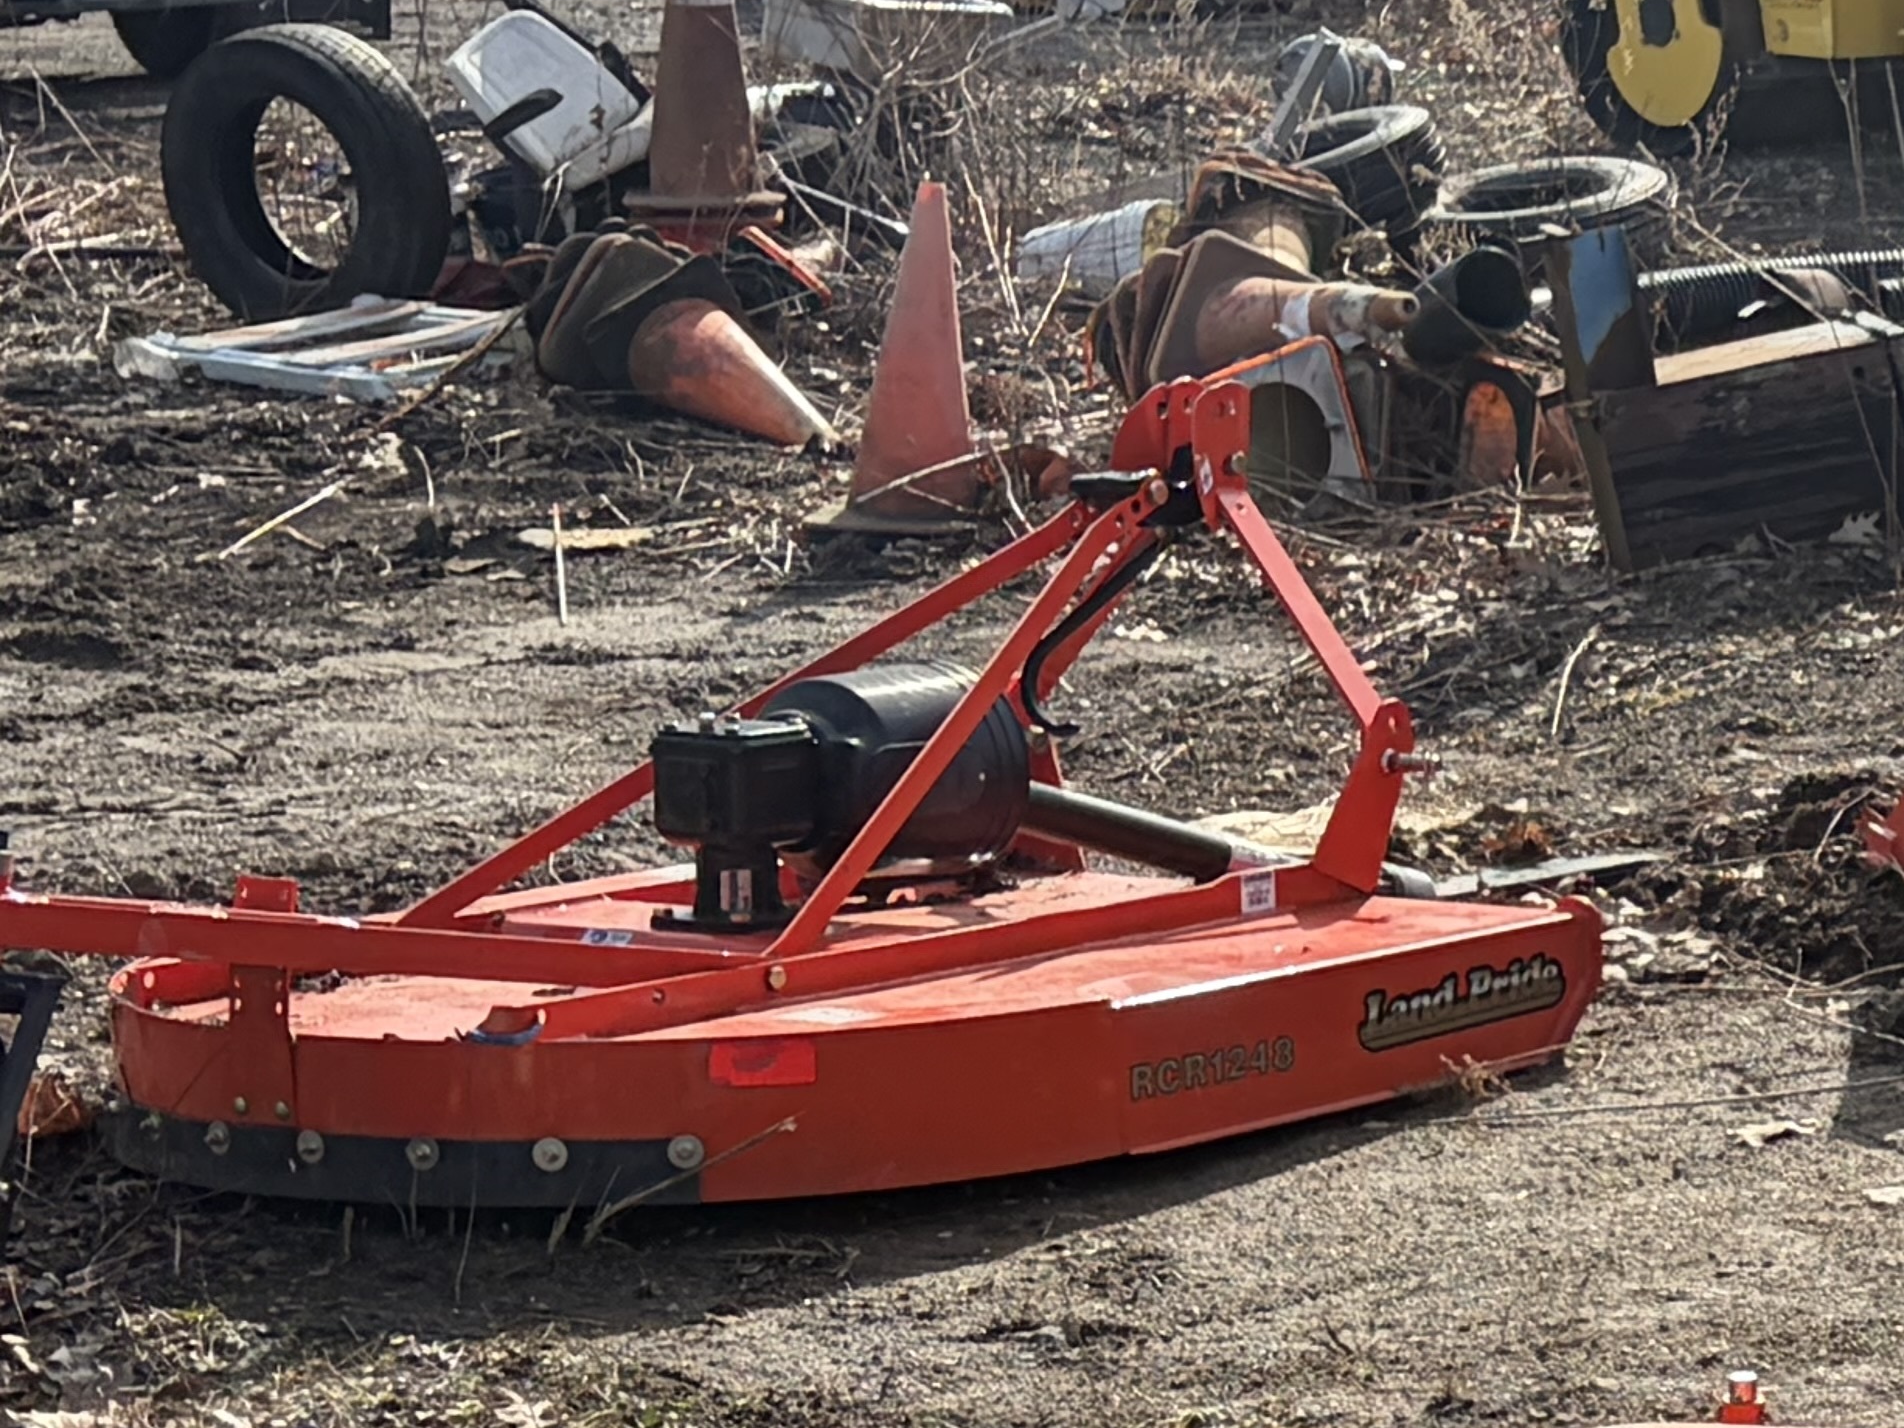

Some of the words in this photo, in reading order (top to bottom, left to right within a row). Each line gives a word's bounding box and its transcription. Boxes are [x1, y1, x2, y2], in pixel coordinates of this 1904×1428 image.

[1366, 973, 1458, 1025] Land
[1468, 953, 1561, 1001] Pride
[1130, 1036, 1295, 1102] RCR1248
